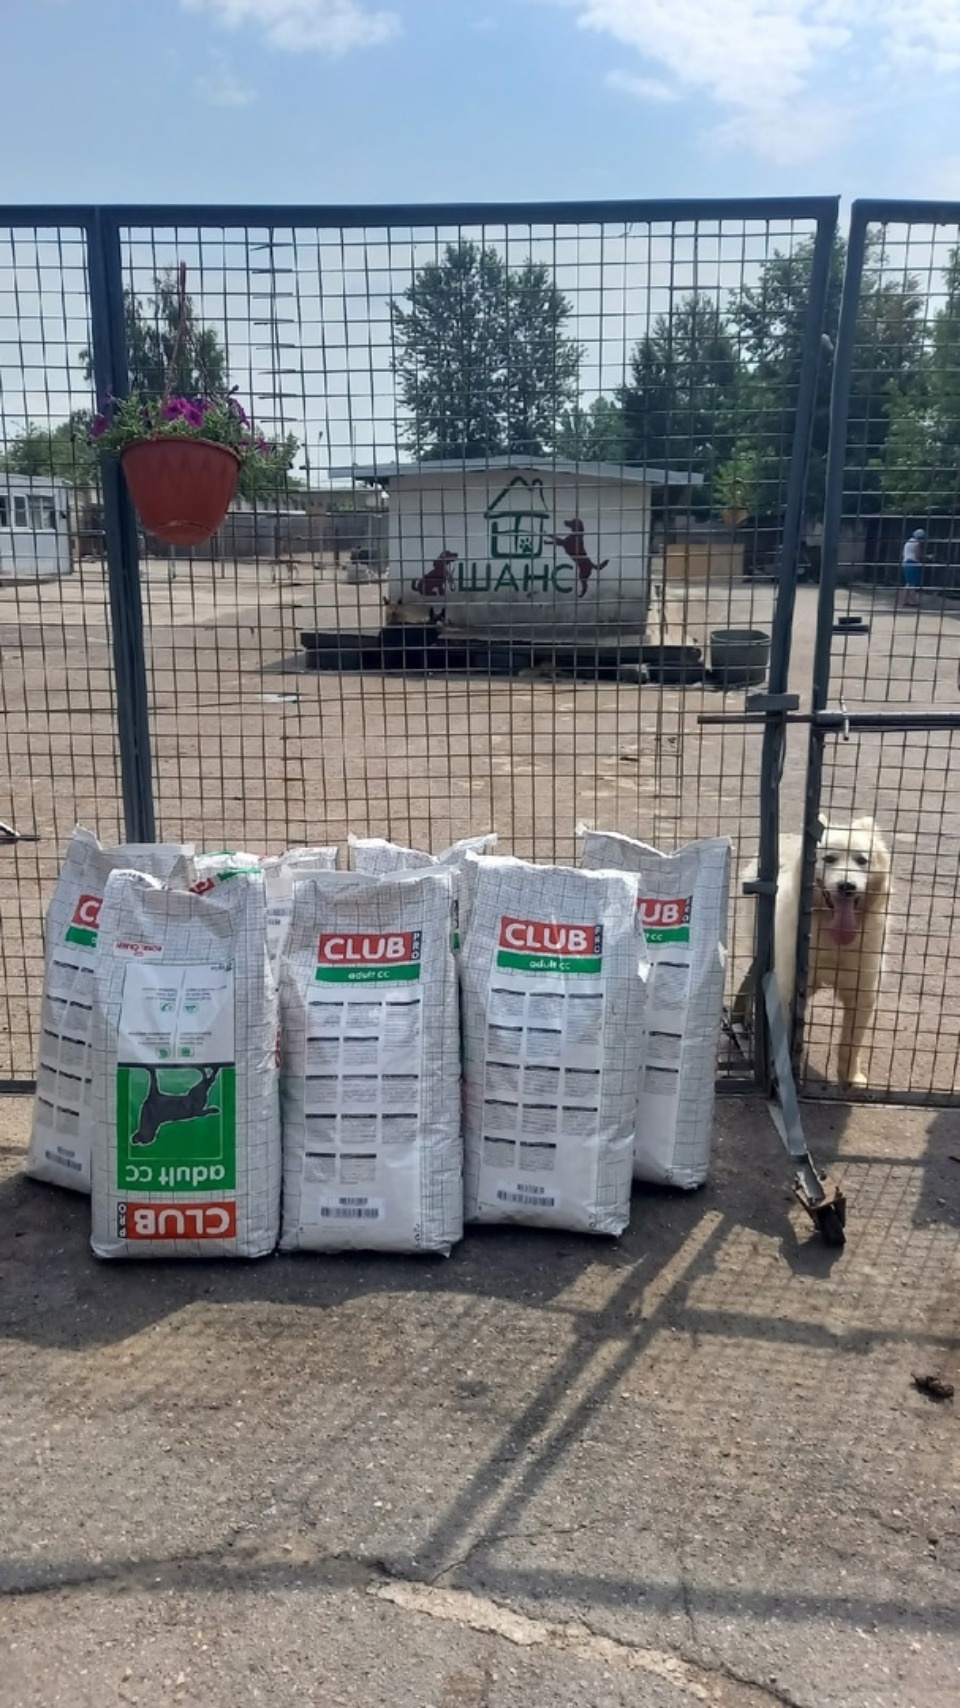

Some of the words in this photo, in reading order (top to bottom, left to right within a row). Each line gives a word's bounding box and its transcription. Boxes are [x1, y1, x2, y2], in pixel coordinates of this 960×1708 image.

[458, 562, 574, 594] ШАНС
[637, 902, 679, 923] UB
[324, 937, 405, 960] CLUB
[411, 932, 420, 960] PRO
[505, 923, 587, 951] CLUB
[348, 970, 375, 979] adult
[529, 960, 557, 969] adult
[125, 1165, 153, 1182] cc
[158, 1165, 225, 1187] adult
[118, 1203, 127, 1237] PRO
[133, 1207, 230, 1235] CLUB
